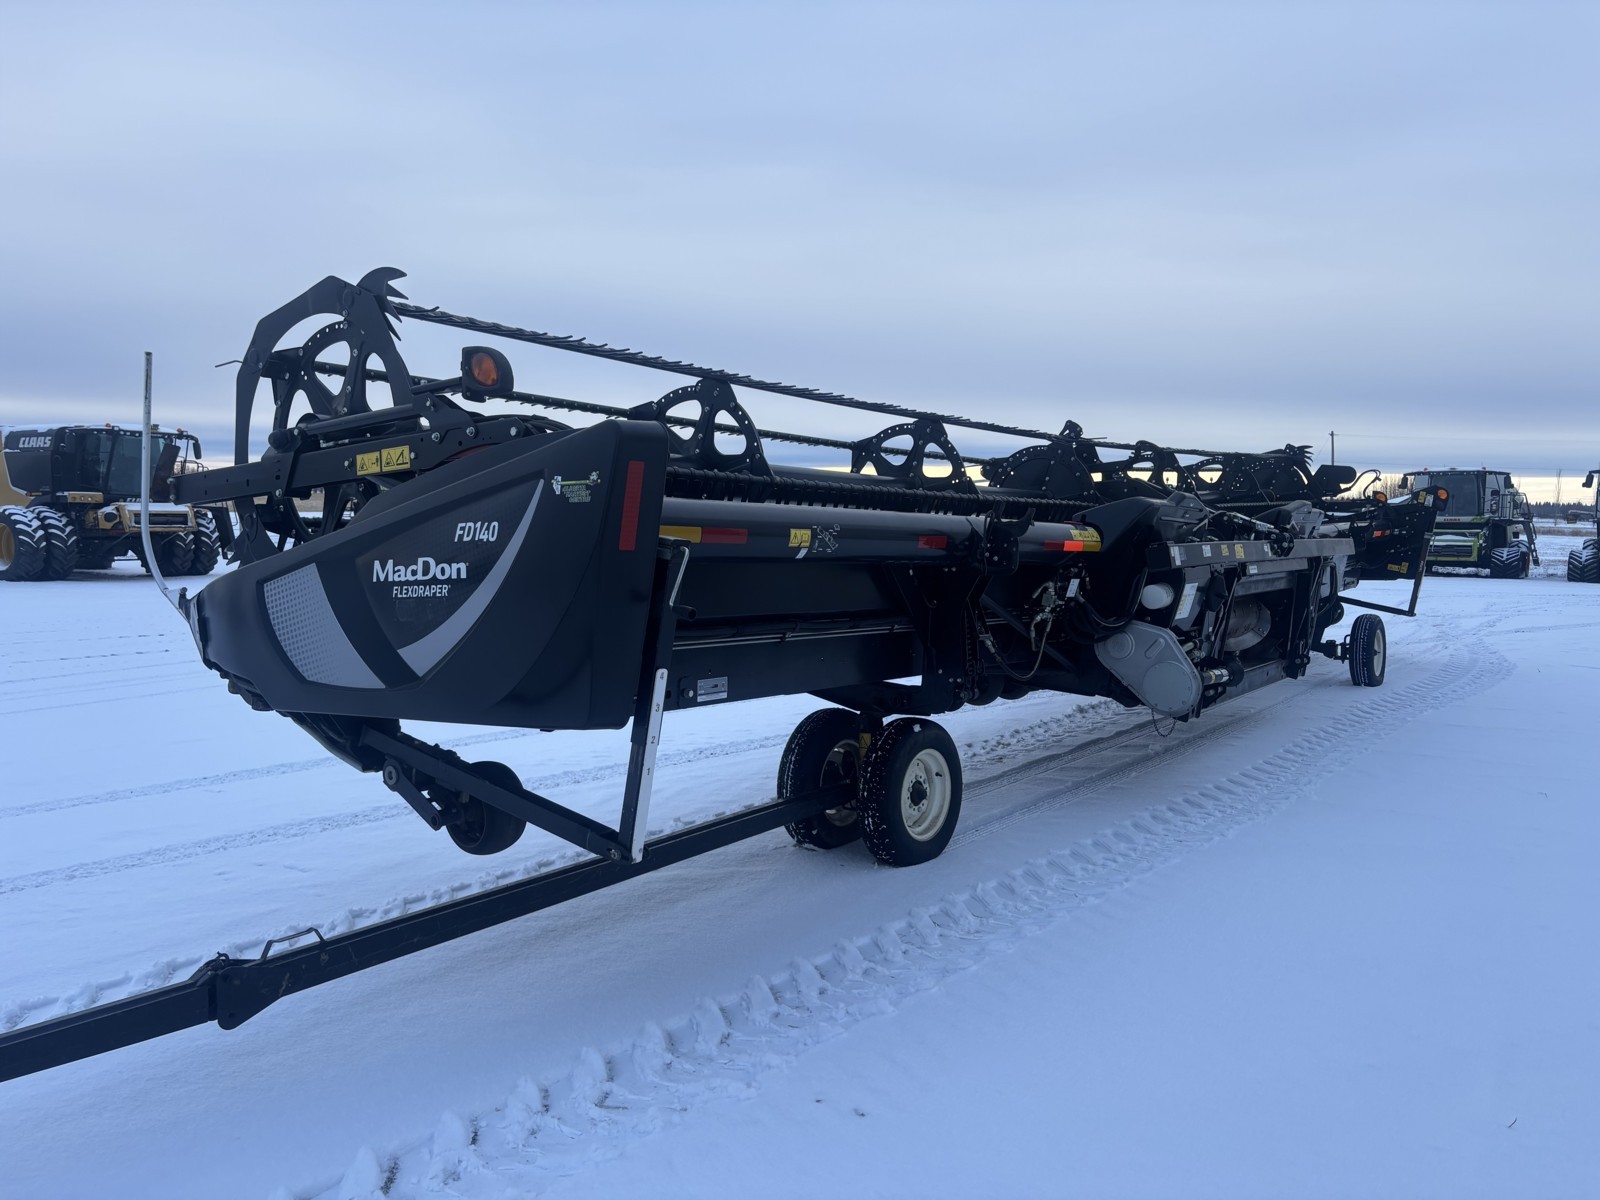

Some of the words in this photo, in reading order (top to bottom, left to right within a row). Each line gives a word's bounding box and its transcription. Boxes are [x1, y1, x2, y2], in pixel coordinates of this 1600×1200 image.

[19, 436, 52, 448] CLAAS
[454, 521, 499, 542] FD140
[372, 556, 468, 582] MacDon
[392, 584, 449, 598] FLEXDRAPER
[655, 702, 661, 713] 3
[650, 735, 656, 745] 2
[646, 767, 651, 776] 1
